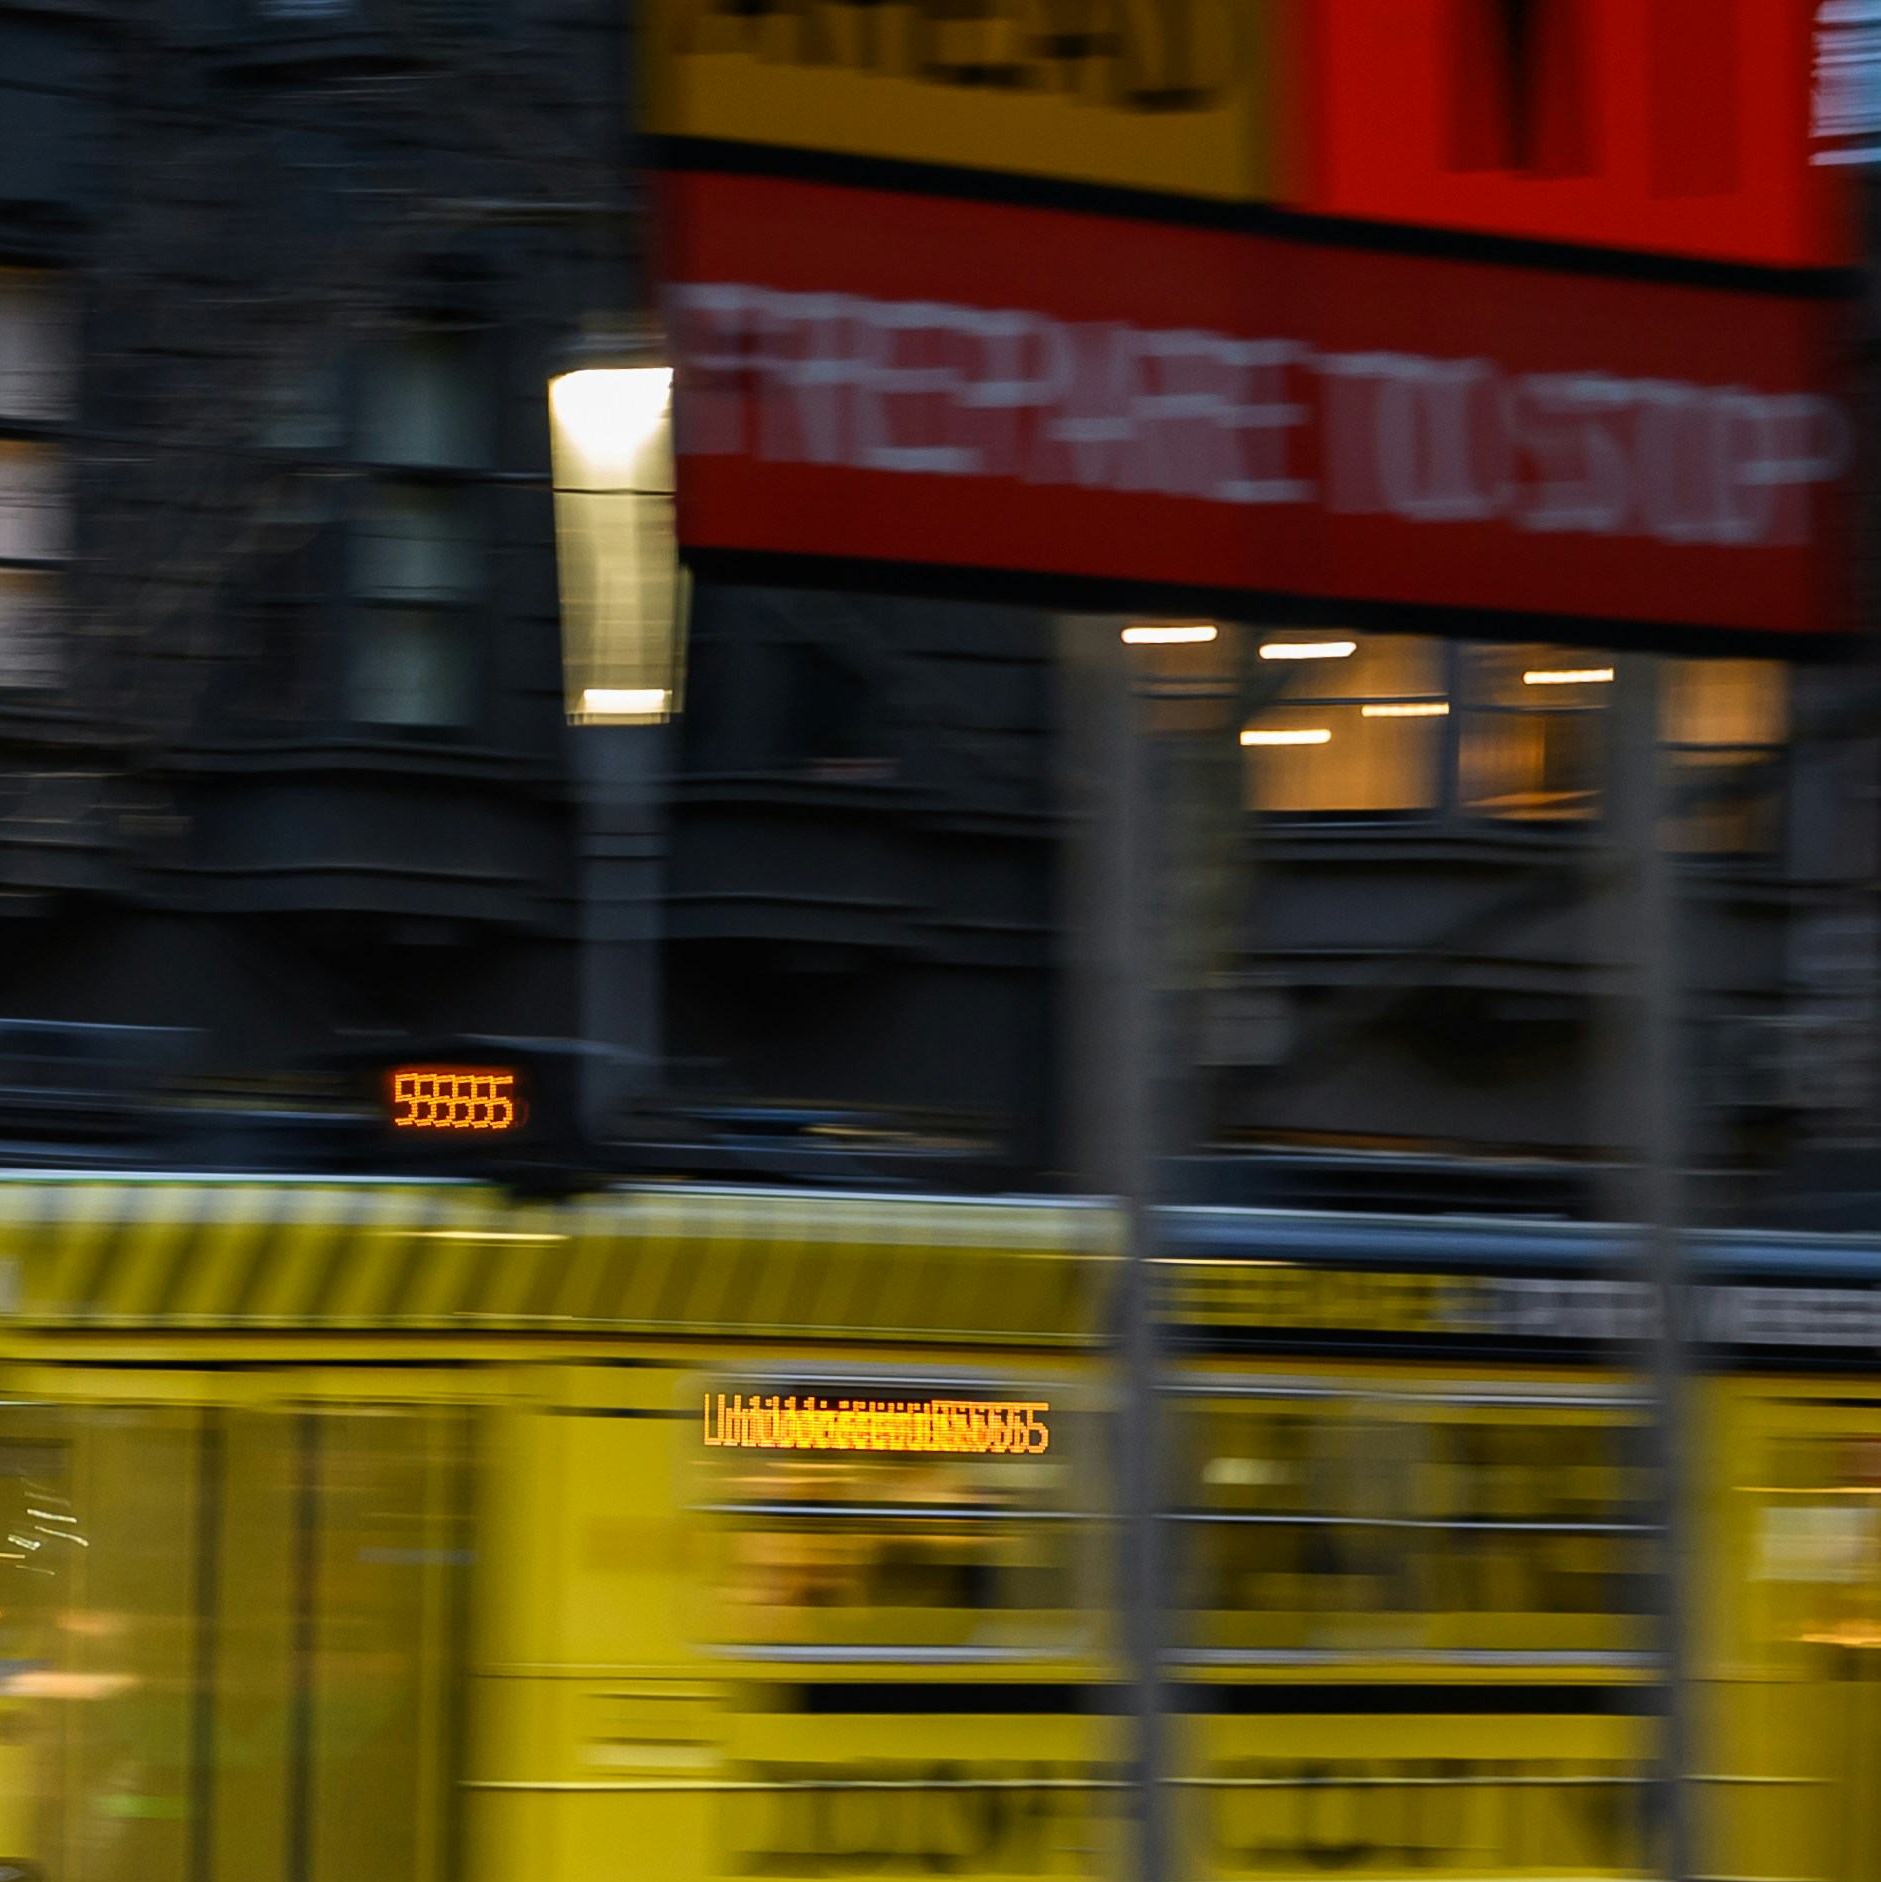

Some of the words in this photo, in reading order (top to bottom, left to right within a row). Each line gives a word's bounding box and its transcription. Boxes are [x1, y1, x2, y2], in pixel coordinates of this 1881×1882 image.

[667, 281, 1317, 504] PREPARE
[1303, 350, 1505, 522] TO
[1499, 370, 1857, 548] STOP
